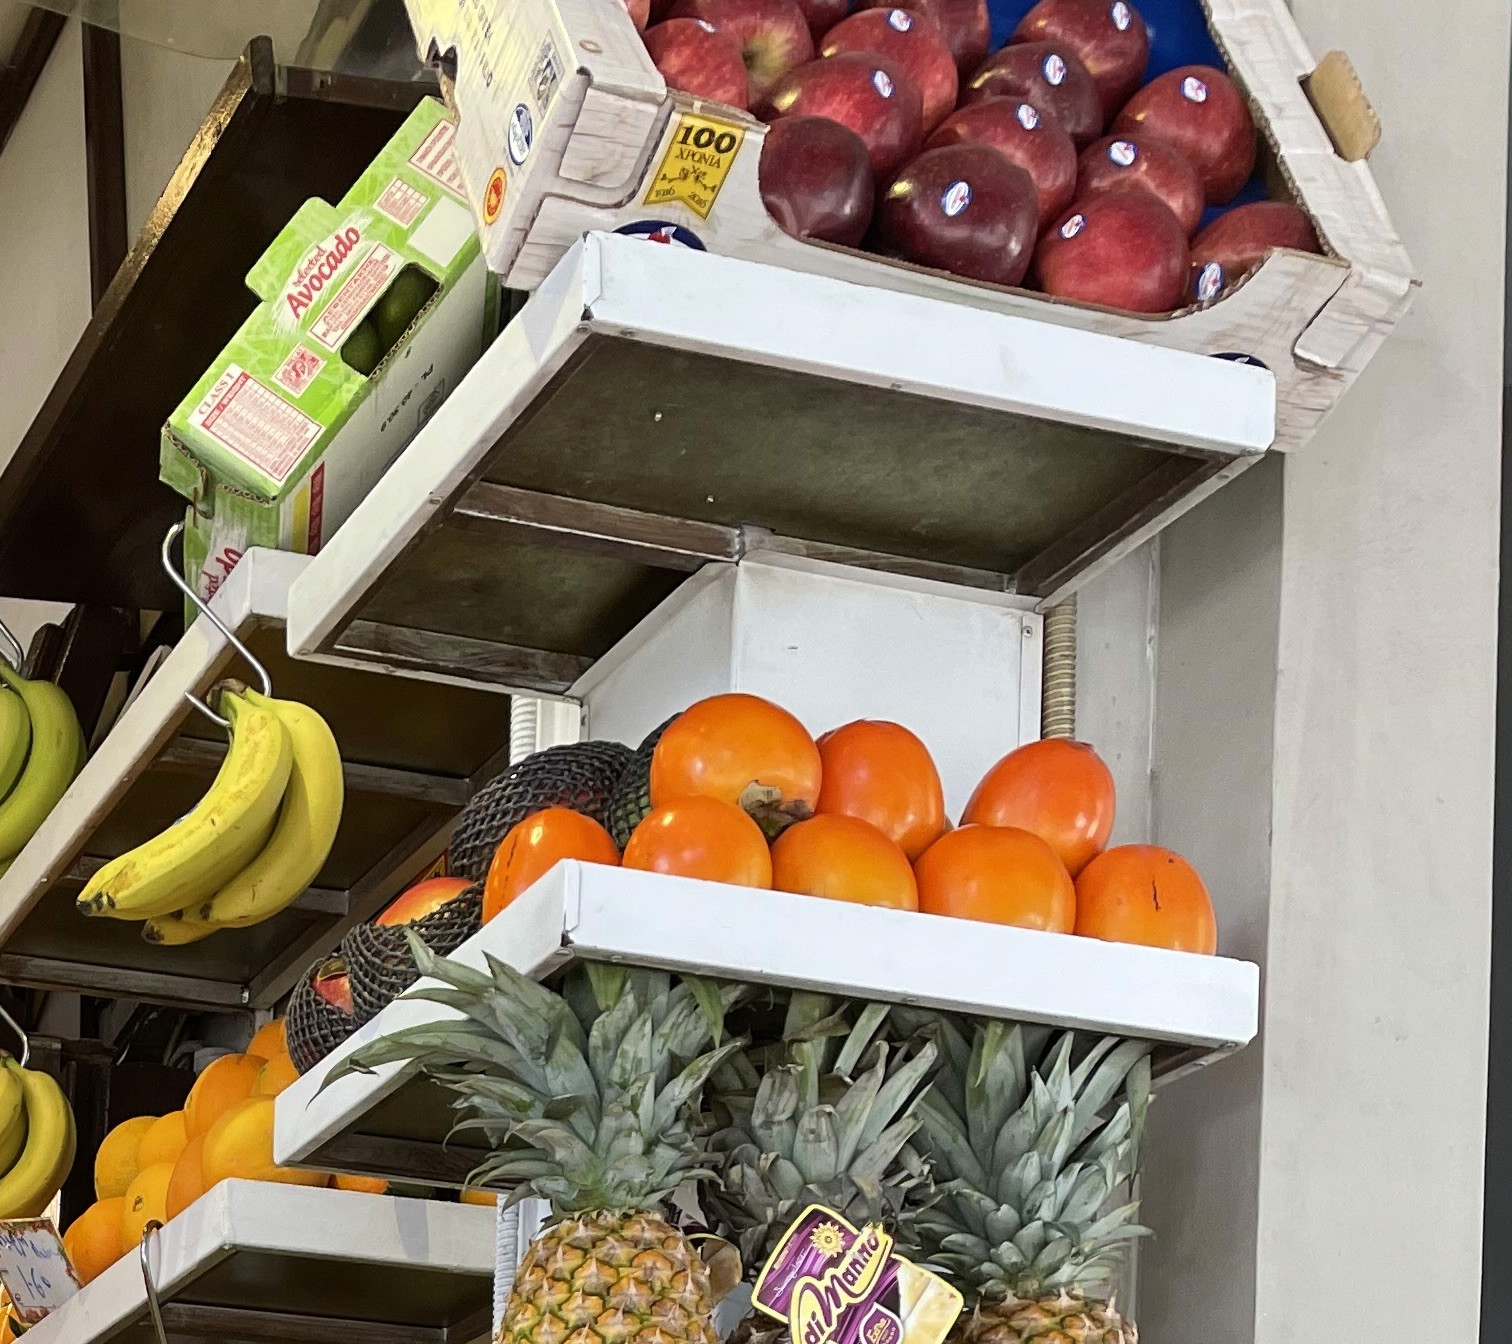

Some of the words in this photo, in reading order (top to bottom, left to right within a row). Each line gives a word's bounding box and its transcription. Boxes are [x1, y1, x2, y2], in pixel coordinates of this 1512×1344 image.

[675, 147, 721, 168] ΧΡΟΝΙΑ
[679, 126, 736, 154] 100
[287, 227, 360, 318] Avocado
[198, 380, 230, 416] CLASS
[802, 1234, 880, 1328] Manno
